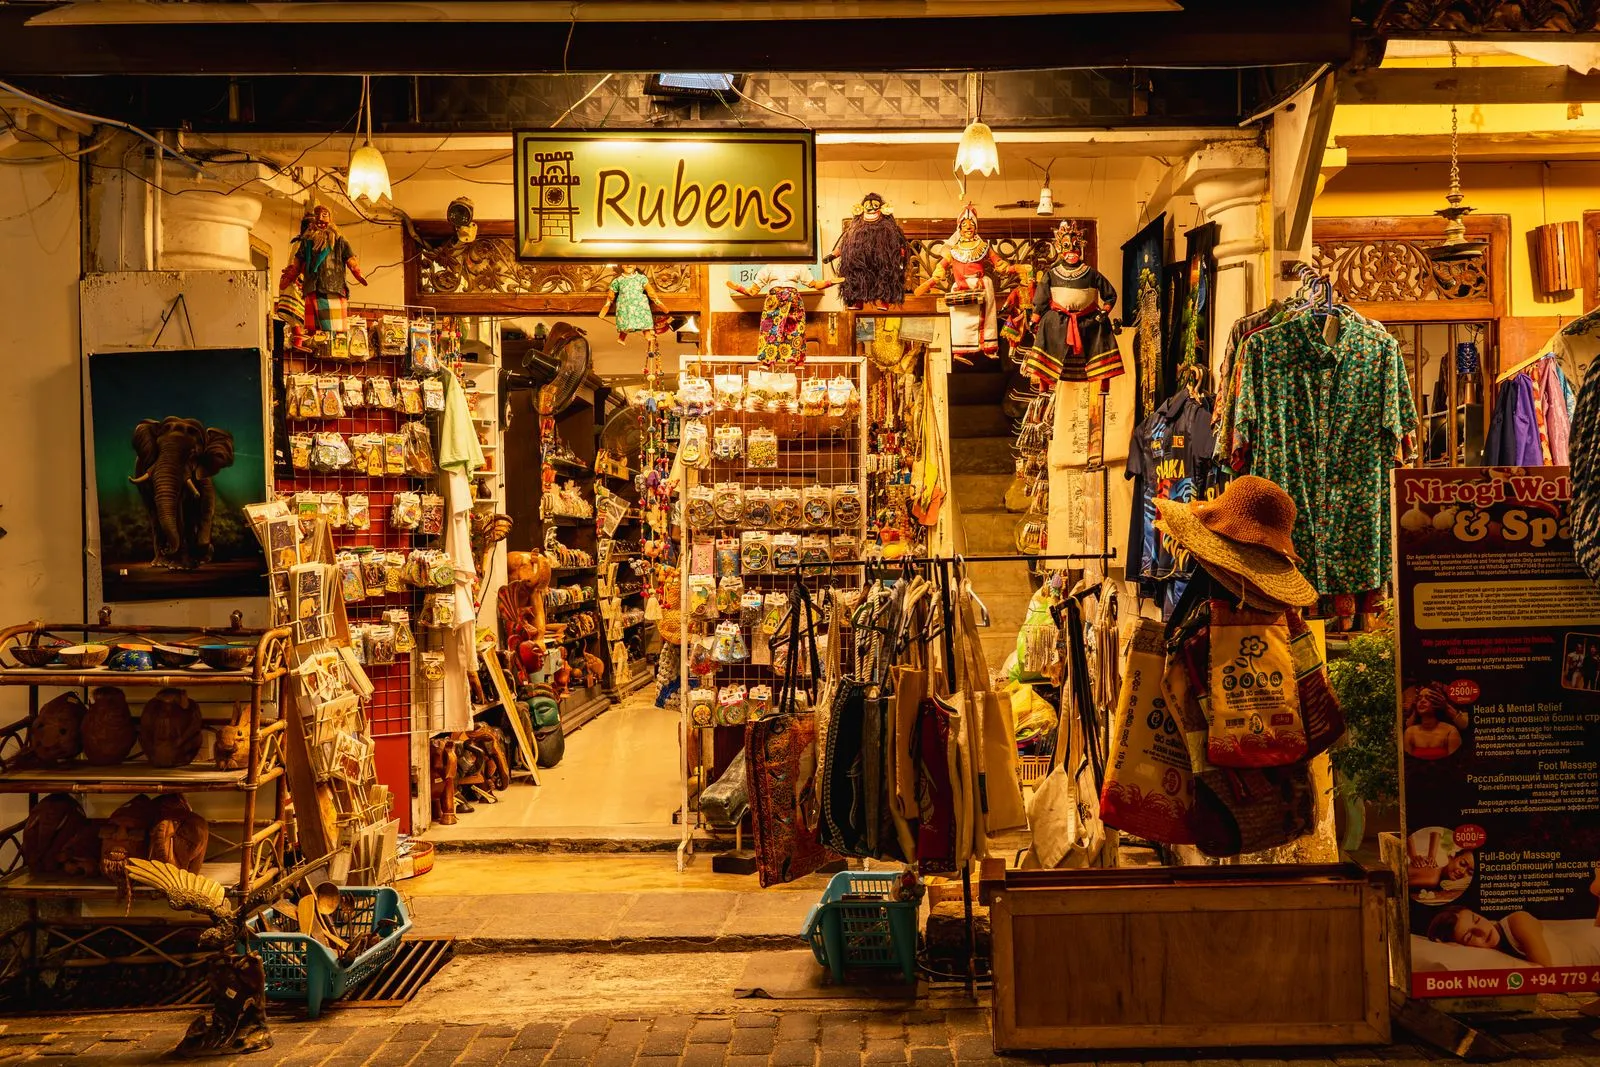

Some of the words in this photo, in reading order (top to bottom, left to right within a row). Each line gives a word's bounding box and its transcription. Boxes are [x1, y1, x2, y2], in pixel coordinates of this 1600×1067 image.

[597, 158, 794, 230] Rubens
[1404, 477, 1504, 508] Nirogi
[1510, 476, 1572, 502] Wel
[1454, 510, 1490, 542] &
[1450, 686, 1478, 696] 2500/=
[1473, 705, 1495, 714] Head
[1498, 704, 1504, 712] &
[1507, 703, 1535, 712] Mental
[1538, 702, 1562, 712] Relief
[1474, 716, 1506, 724] Снятие
[1508, 714, 1549, 723] головной
[1552, 713, 1574, 722] боли
[1474, 727, 1505, 735] Ayurvedic
[1516, 726, 1542, 734] massage
[1538, 761, 1558, 770] Foot
[1560, 760, 1597, 771] Massage
[1467, 773, 1541, 784] Расслабляющий
[1544, 774, 1576, 782] массаж
[1578, 772, 1598, 782] стоп
[1456, 832, 1484, 842] 5000/=
[1479, 851, 1521, 862] Full-Body
[1523, 850, 1561, 862] Massage
[1480, 860, 1553, 872] Расслабляющий
[1556, 861, 1588, 870] массаж
[1480, 874, 1507, 882] Provided
[1509, 873, 1516, 882] by
[1523, 872, 1553, 880] traditional
[1493, 882, 1520, 890] massage
[1426, 977, 1462, 990] Book
[1468, 976, 1499, 988] Now
[1530, 973, 1556, 986] +94
[1561, 972, 1587, 984] 779
